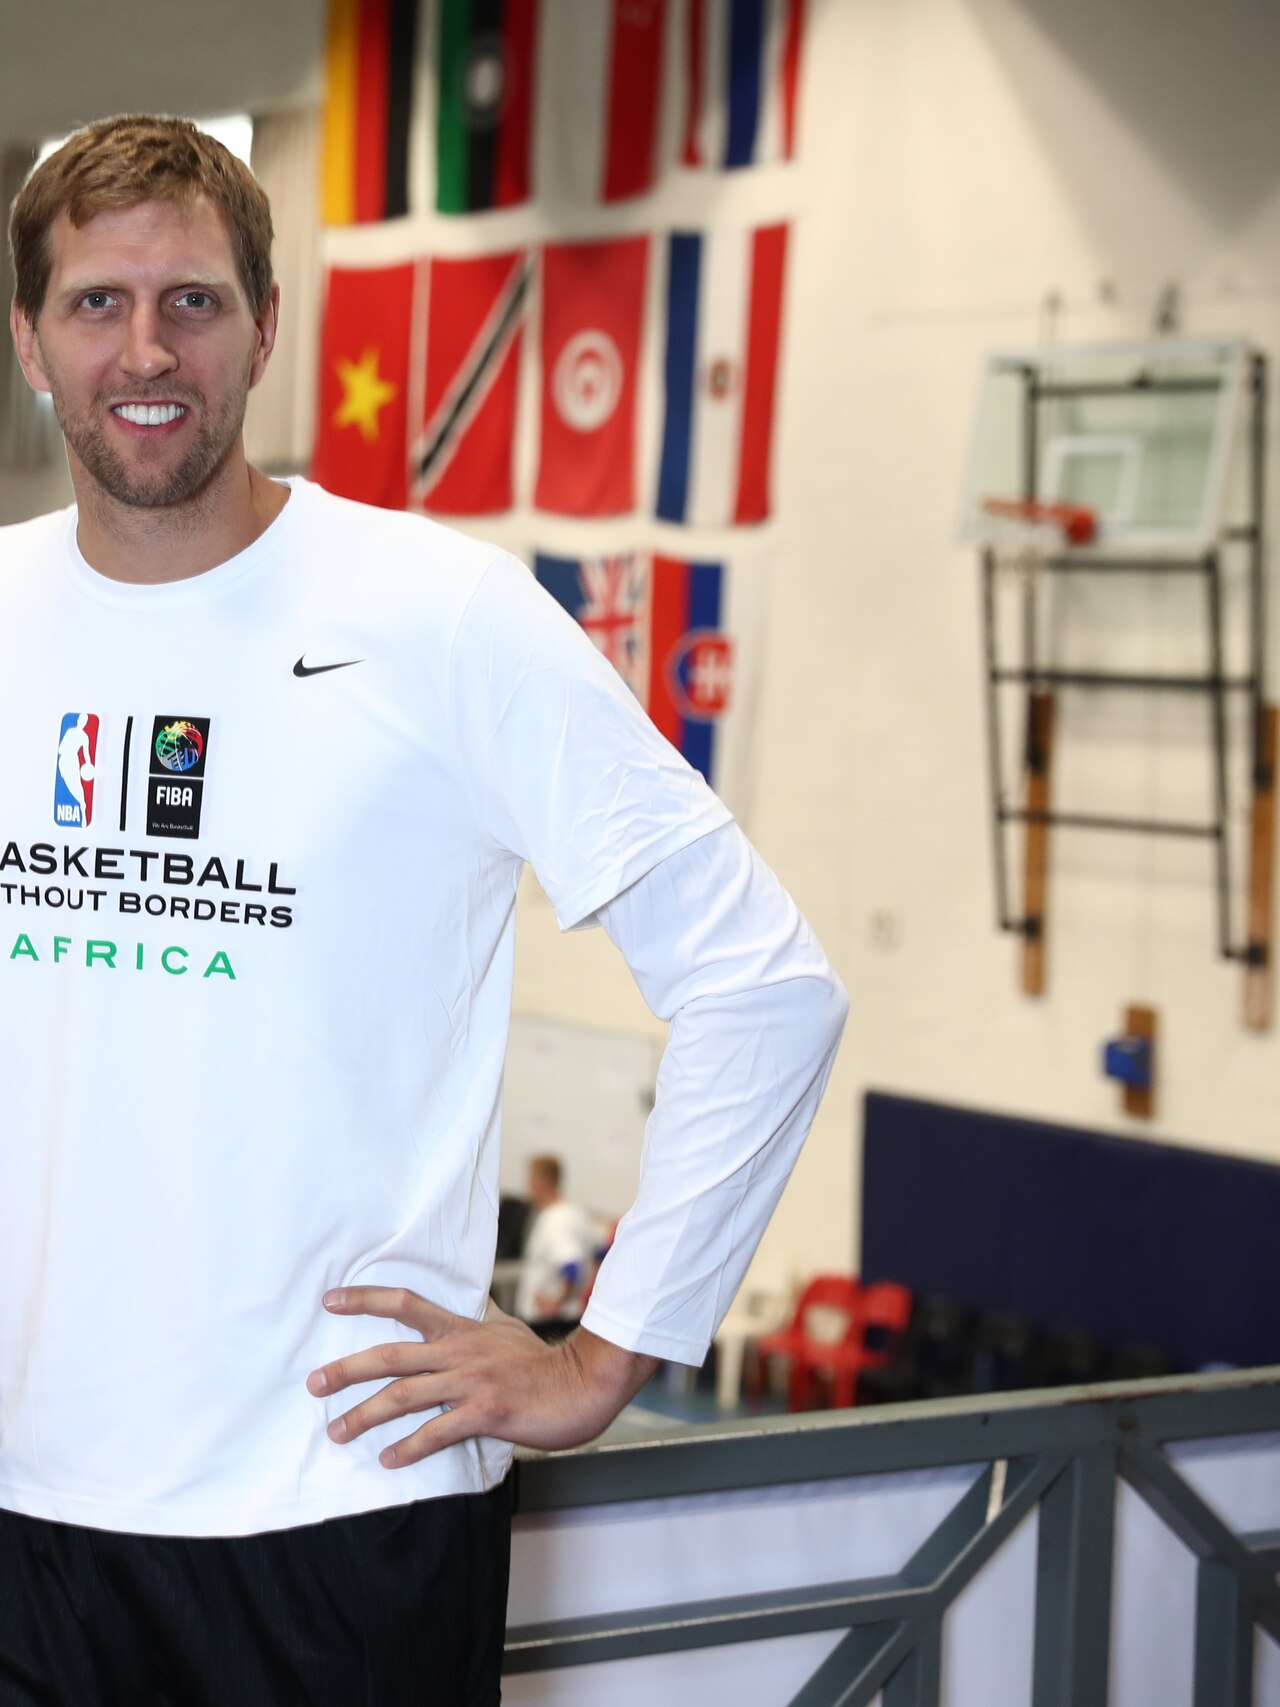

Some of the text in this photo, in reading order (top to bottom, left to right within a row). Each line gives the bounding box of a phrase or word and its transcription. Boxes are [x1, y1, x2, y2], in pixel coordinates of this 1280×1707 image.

[156, 785, 193, 807] FIBA
[57, 804, 80, 822] NBA
[120, 892, 293, 928] BORDERS
[10, 933, 236, 980] AFRICA
